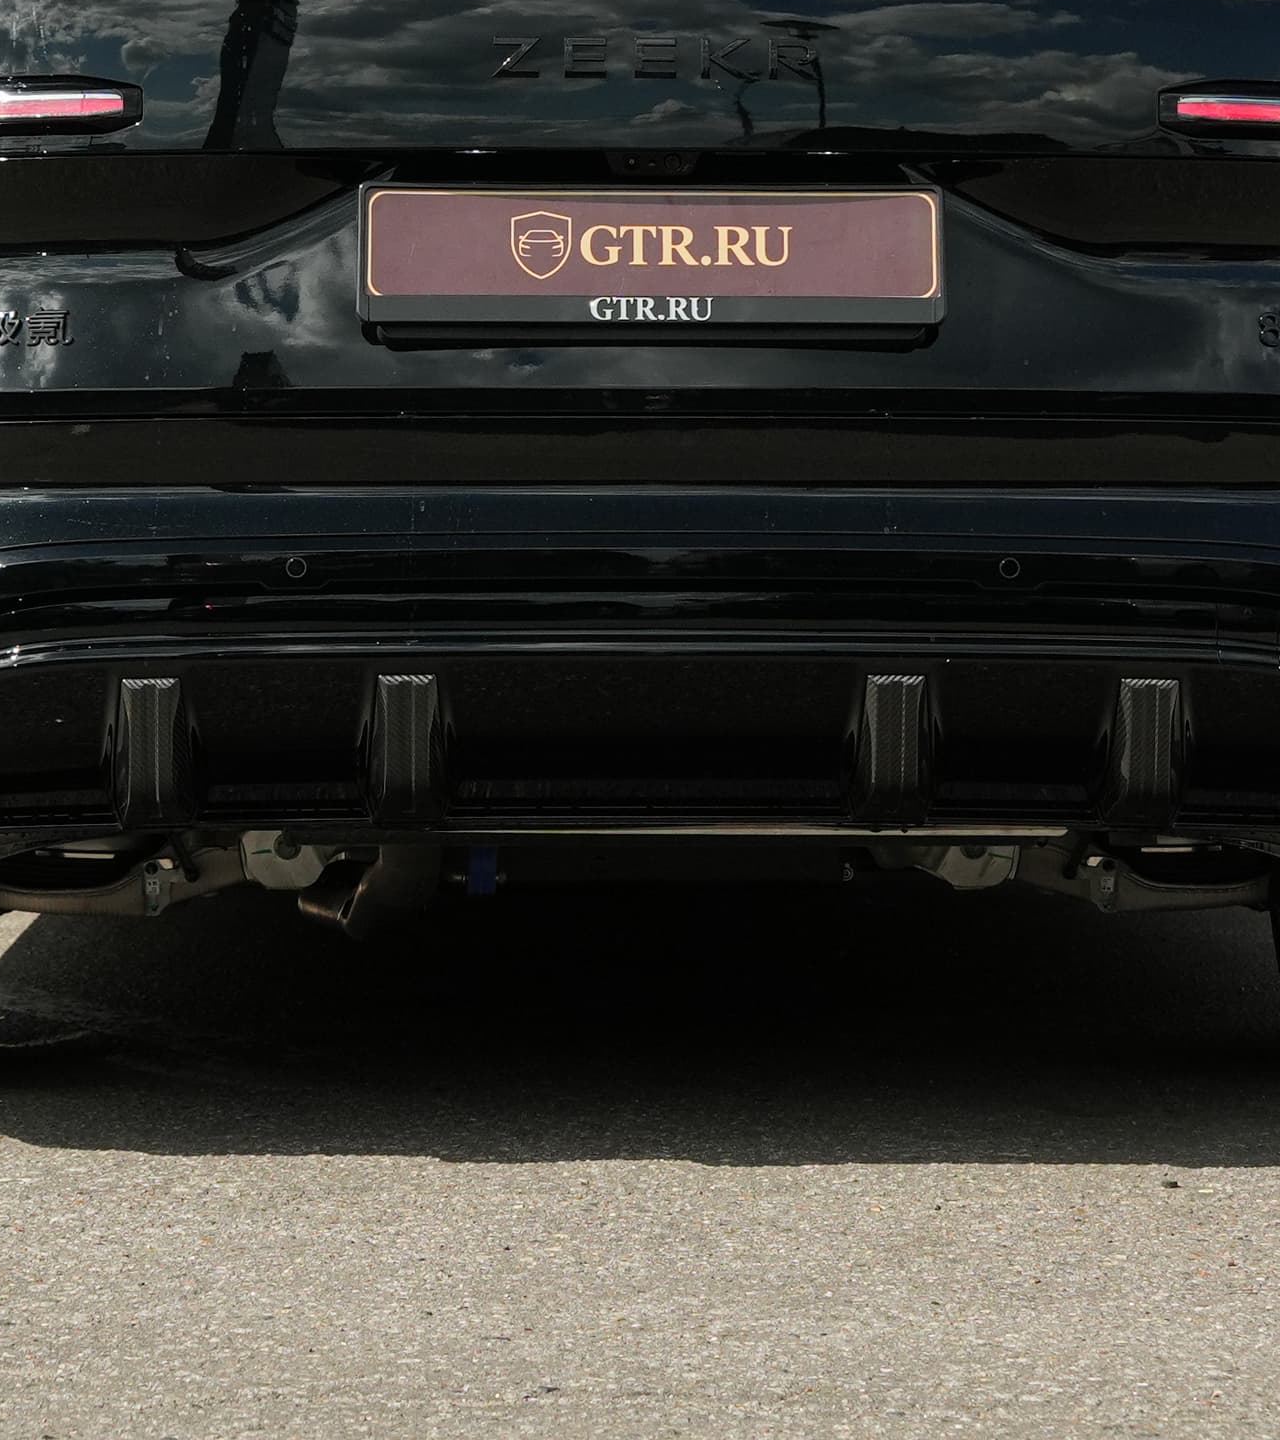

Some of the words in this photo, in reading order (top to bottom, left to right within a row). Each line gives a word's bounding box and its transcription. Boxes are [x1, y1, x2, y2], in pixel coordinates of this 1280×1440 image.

[491, 35, 818, 81] ZEEKR
[580, 224, 793, 266] GTR.RU
[589, 296, 713, 321] GTR.RU
